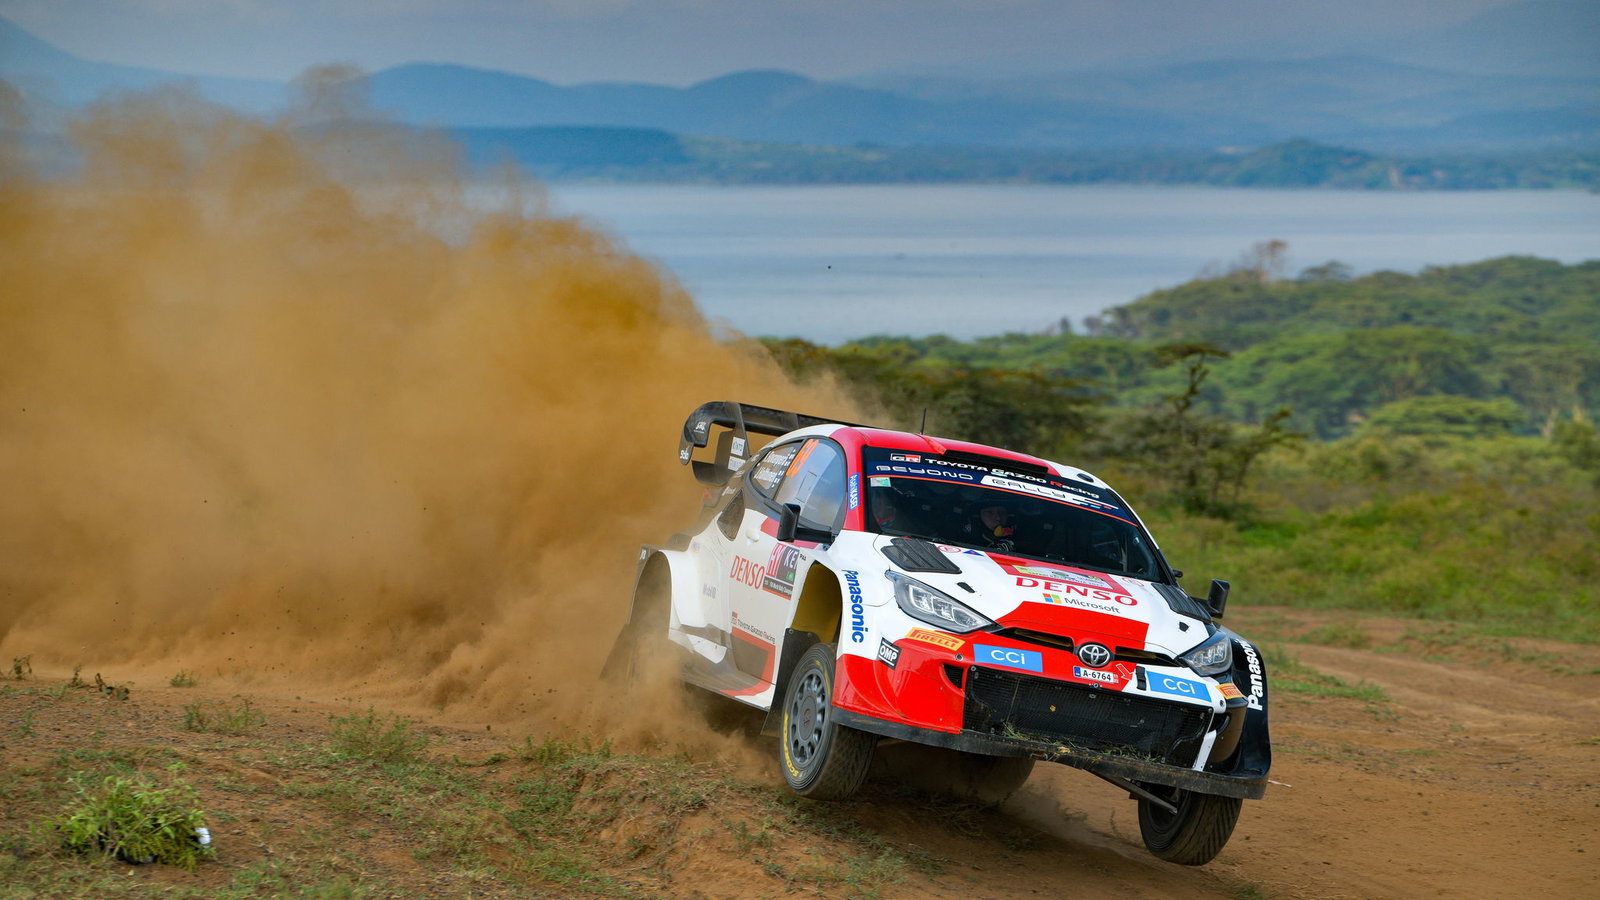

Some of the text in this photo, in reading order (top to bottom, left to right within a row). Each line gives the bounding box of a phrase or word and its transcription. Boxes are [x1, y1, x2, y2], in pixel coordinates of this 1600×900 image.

[876, 465, 1066, 498] BEYOND RALLY
[925, 458, 988, 472] TOYOTA
[1050, 481, 1100, 499] Racing
[729, 555, 765, 589] DENSO
[841, 569, 868, 643] Panasonic
[1015, 577, 1138, 606] DENSO
[1064, 597, 1120, 614] Microsoft
[910, 629, 962, 648] PIRELLI
[880, 645, 898, 662] OMP
[1083, 670, 1111, 681] A-6764
